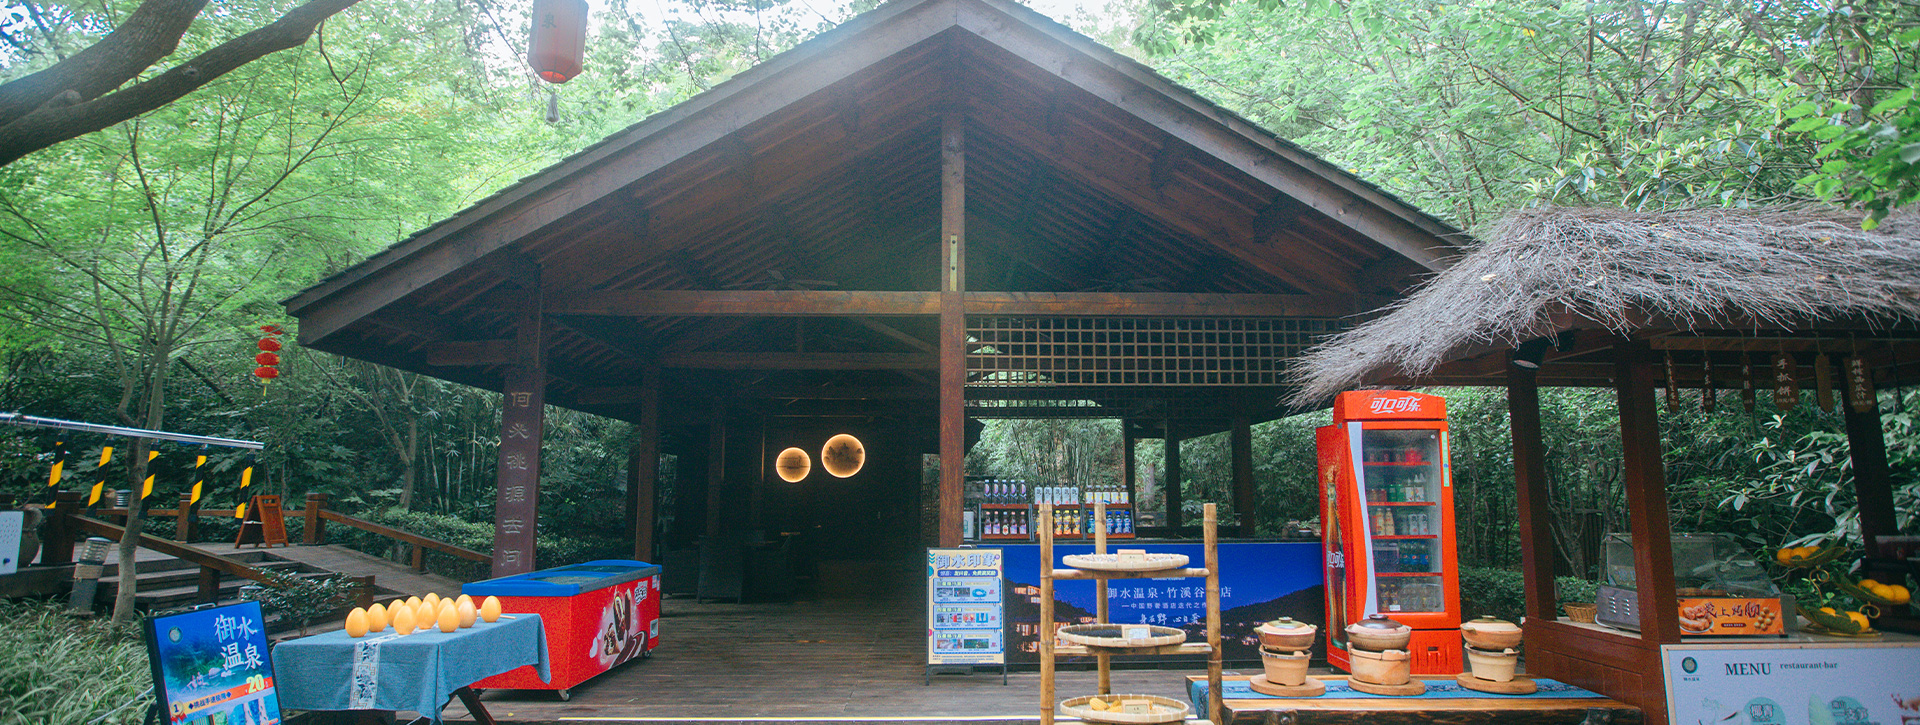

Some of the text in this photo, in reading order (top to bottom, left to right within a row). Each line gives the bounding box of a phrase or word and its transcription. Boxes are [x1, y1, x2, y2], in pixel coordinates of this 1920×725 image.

[1370, 395, 1423, 414] 可口可乐
[936, 552, 997, 569] 御水印象
[1108, 586, 1232, 599] 御水温泉·竹溪谷店
[213, 613, 258, 643] 御水
[220, 642, 264, 671] 温泉
[1724, 662, 1771, 675] MENU
[246, 674, 265, 693] 20
